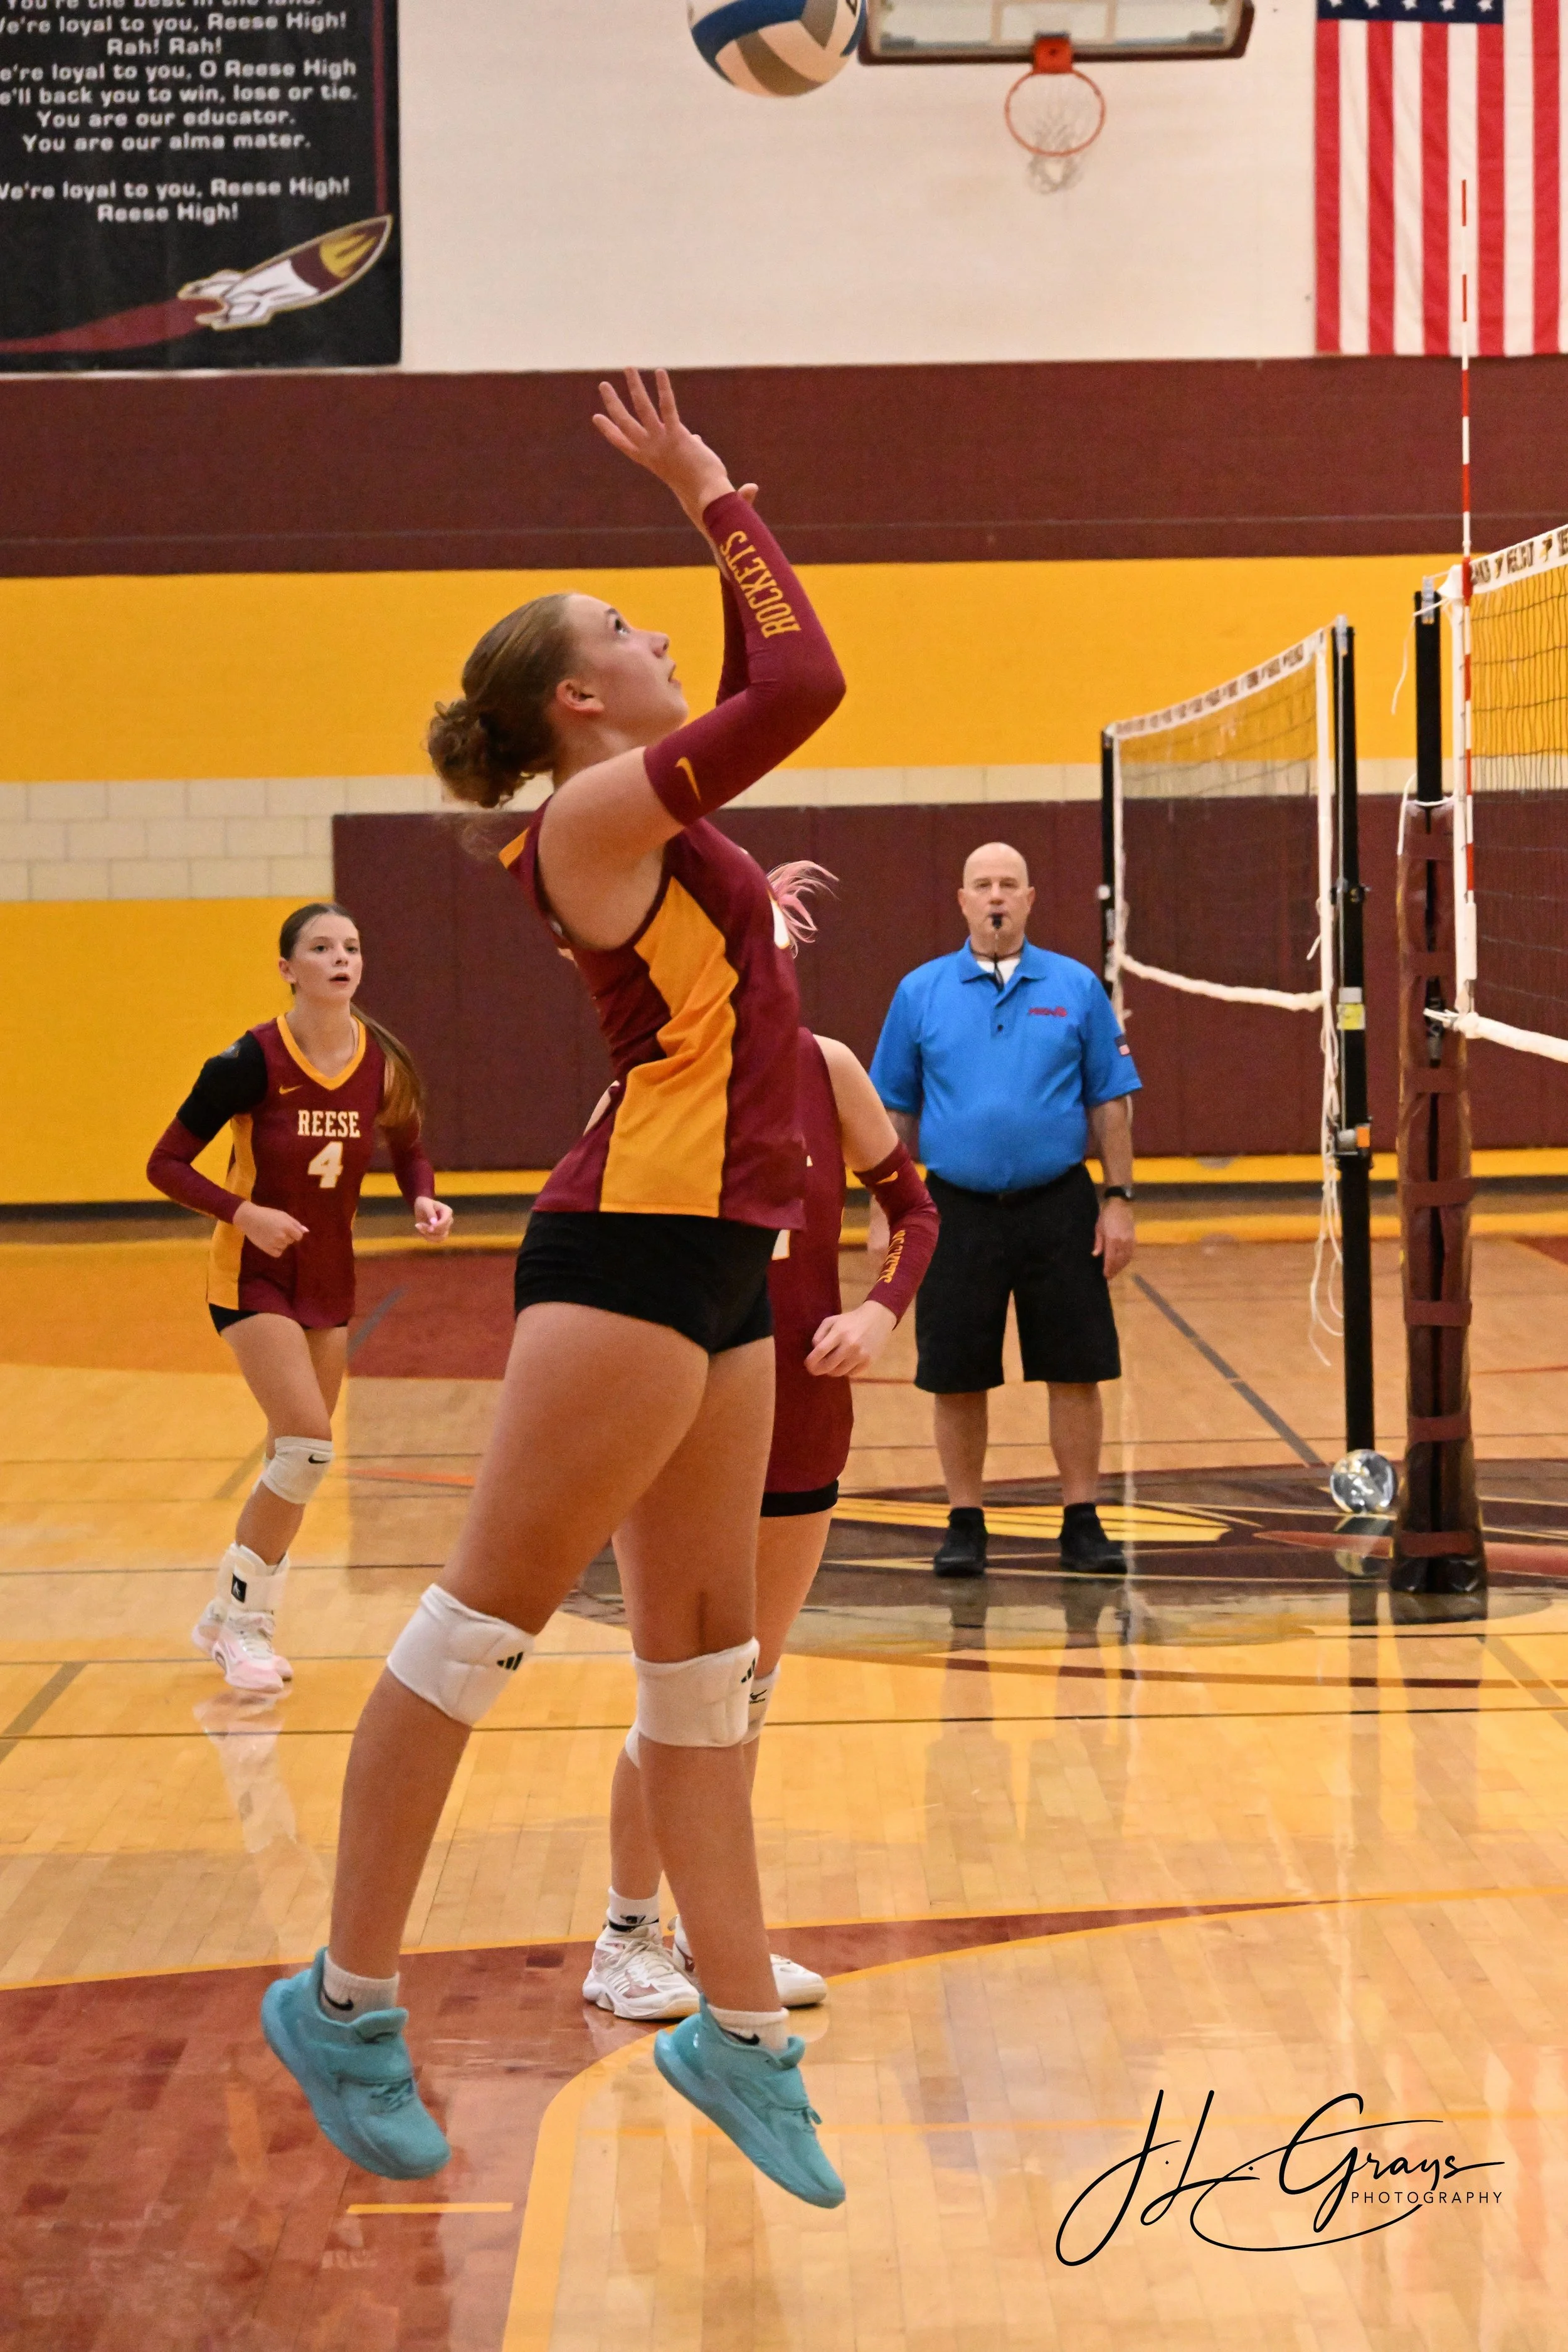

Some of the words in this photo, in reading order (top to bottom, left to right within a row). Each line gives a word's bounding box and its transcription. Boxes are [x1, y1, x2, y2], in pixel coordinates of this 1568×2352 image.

[0, 16, 51, 34] e're
[60, 16, 113, 37] loyal
[120, 16, 145, 32] to
[152, 18, 199, 35] you,
[208, 13, 278, 31] Reese
[286, 11, 347, 34] High!
[107, 38, 159, 56] Rah!
[169, 36, 222, 55] Rah!
[52, 63, 105, 84] loyal
[114, 64, 138, 80] to
[199, 60, 218, 78] O
[225, 60, 296, 78] Reese
[304, 58, 357, 80] High
[39, 86, 93, 104] back
[101, 90, 140, 109] you
[148, 87, 172, 103] to
[179, 85, 226, 103] win,
[233, 84, 280, 101] lose
[288, 87, 314, 101] or
[36, 110, 80, 128] You
[88, 114, 128, 128] are
[136, 112, 176, 127] our
[183, 107, 296, 126] educator.
[23, 134, 66, 152] You
[75, 137, 114, 152] are
[122, 136, 161, 151] our
[169, 132, 226, 150] alma
[233, 132, 311, 149] mater.
[63, 180, 117, 203] loyal
[124, 182, 149, 198] to
[210, 178, 282, 197] Reese
[289, 177, 350, 200] High!
[97, 203, 169, 222] Reese
[177, 202, 238, 226] High!
[719, 531, 802, 638] ROCKETS
[297, 1109, 361, 1138] REESE
[307, 1140, 344, 1189] 4
